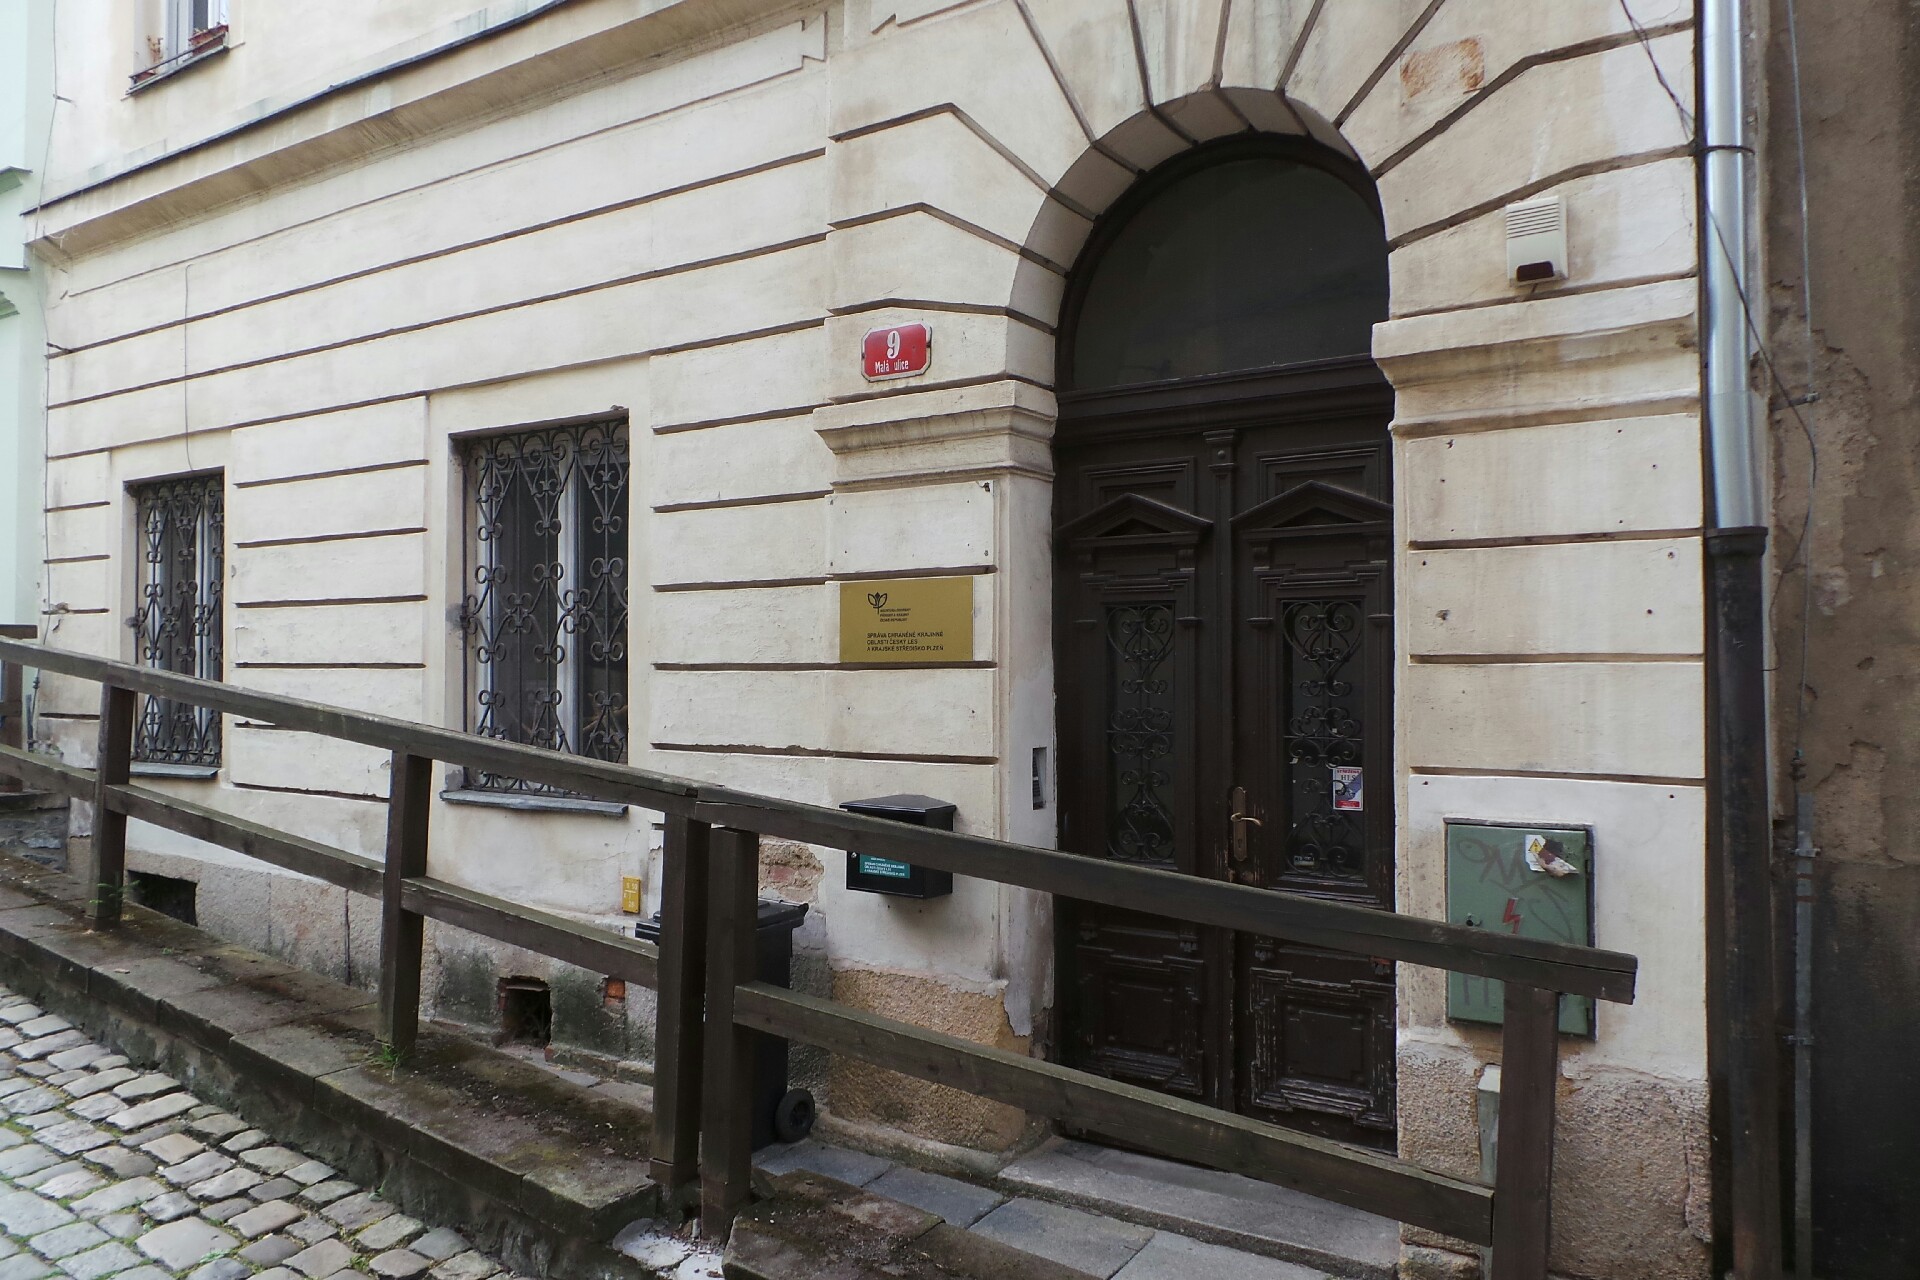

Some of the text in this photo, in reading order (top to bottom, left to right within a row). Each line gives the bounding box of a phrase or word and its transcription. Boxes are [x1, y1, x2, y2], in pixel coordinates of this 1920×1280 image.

[886, 330, 900, 359] 9
[874, 359, 908, 374] Malá ulice
